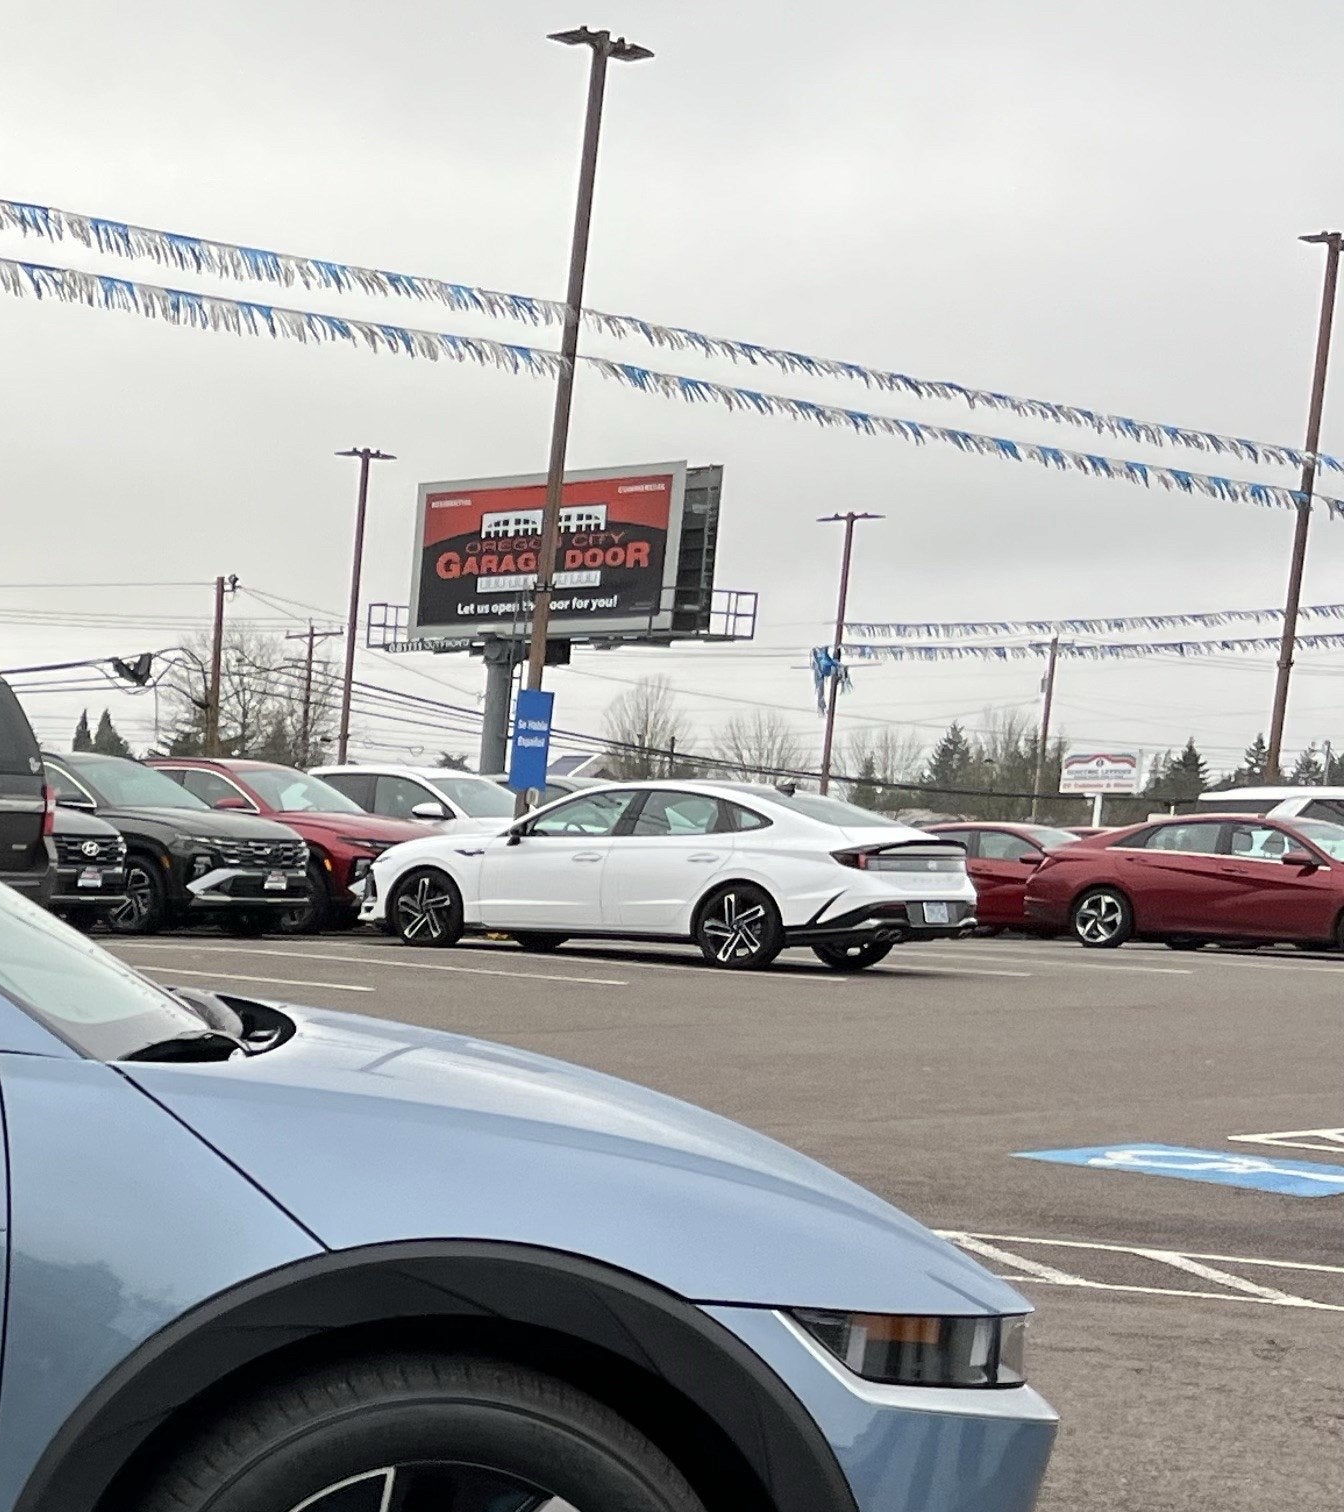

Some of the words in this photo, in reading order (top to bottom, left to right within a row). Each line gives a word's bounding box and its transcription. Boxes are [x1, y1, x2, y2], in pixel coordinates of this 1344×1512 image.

[466, 535, 562, 553] OREGO
[572, 531, 626, 548] CITY
[436, 551, 539, 579] GARAG
[564, 541, 651, 569] DOOR
[456, 603, 475, 615] Let
[477, 604, 490, 614] us
[491, 602, 520, 616] open
[548, 600, 571, 611] oor
[572, 597, 590, 610] for
[590, 595, 618, 612] you!
